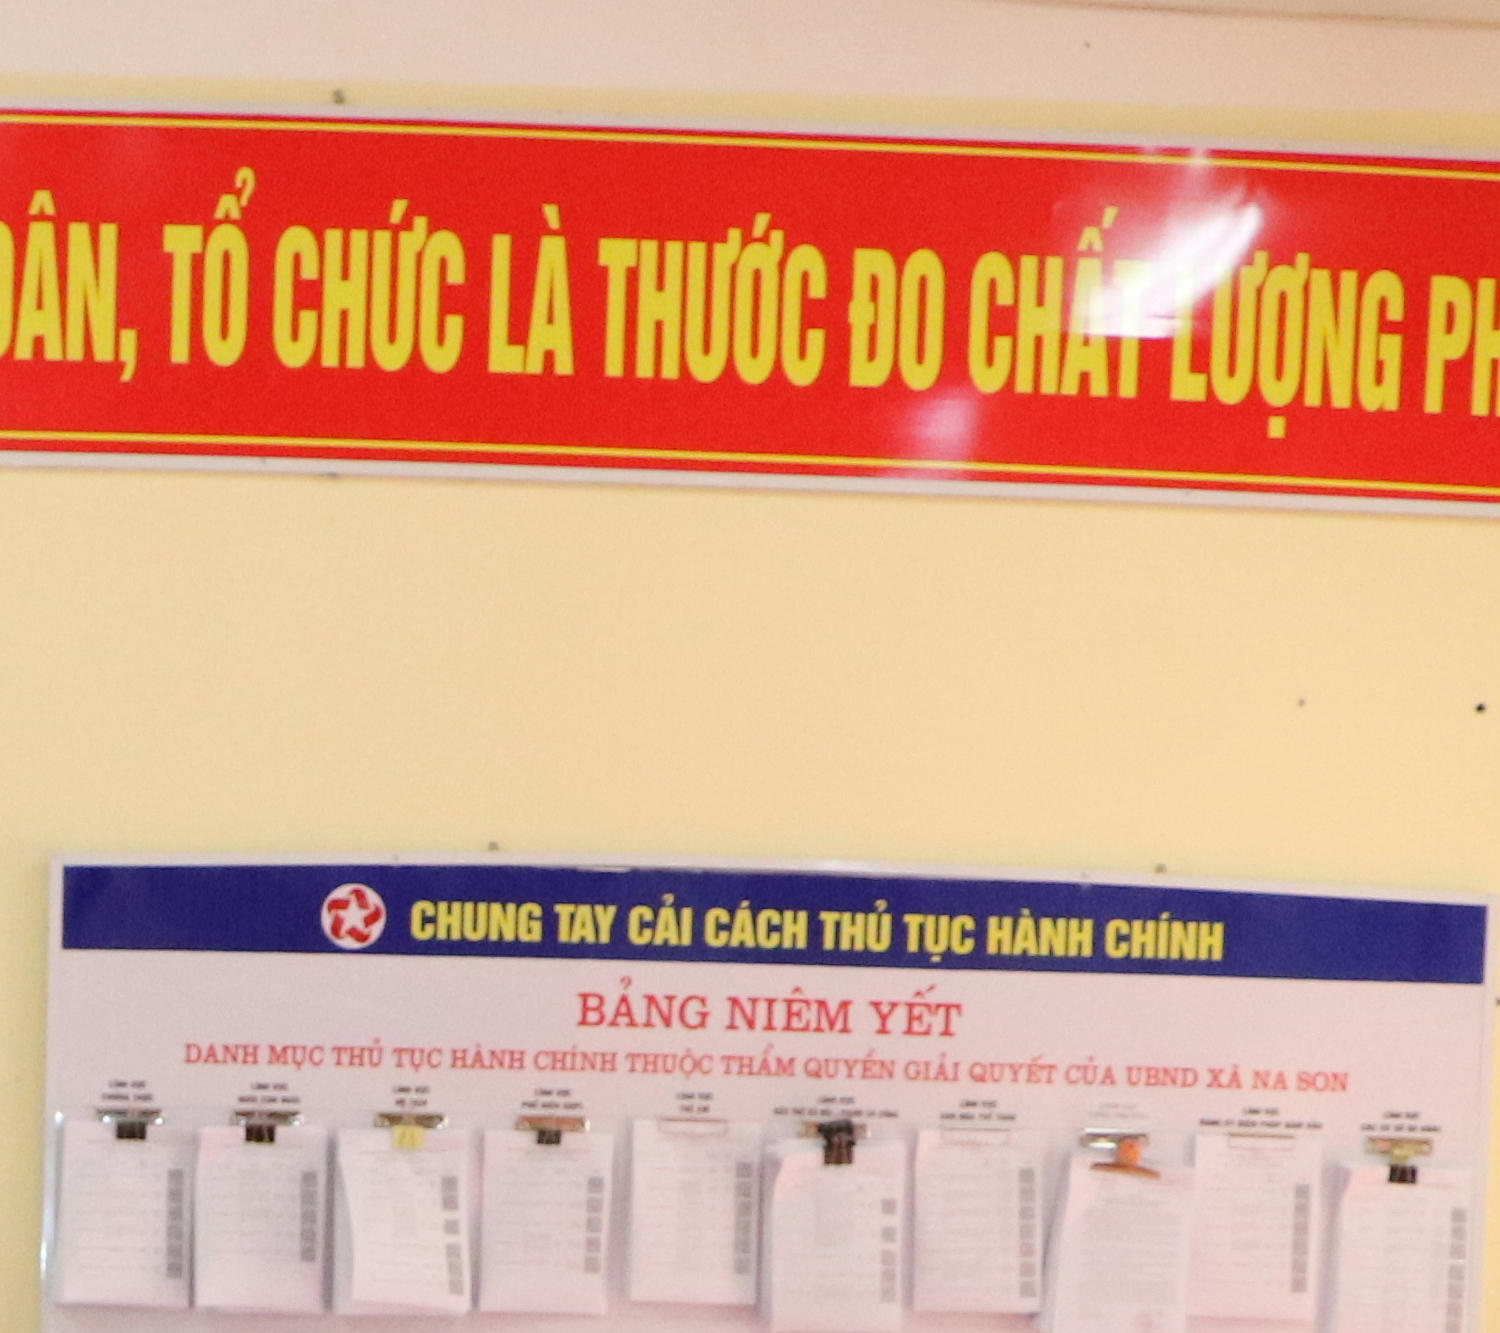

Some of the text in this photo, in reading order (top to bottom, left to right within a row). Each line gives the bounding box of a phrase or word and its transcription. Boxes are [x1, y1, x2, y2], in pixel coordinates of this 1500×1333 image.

[163, 167, 255, 365] TỔ
[273, 199, 465, 372] CHỨC
[489, 204, 573, 374] LÀ
[599, 213, 827, 386] THƯỚC
[848, 249, 945, 390] ĐO
[968, 207, 1150, 398] CHẤT
[1170, 250, 1404, 438] LƯỢNG
[411, 893, 1225, 963] CHUNG TAY CẢI CÁCH THỦ TỤC HÀNH CHÍNH
[576, 976, 964, 1038] BẢNG NIÊM YẾT
[185, 1043, 259, 1066] DANH
[267, 1045, 326, 1070] MỤC
[332, 1037, 383, 1068] THỦ
[393, 1046, 443, 1071] TỤC
[451, 1044, 526, 1071] HÀNH
[533, 1046, 618, 1073] CHÍNH
[625, 1047, 713, 1079] THUỘC
[904, 1053, 961, 1083] GIẢI
[969, 1054, 1058, 1084] QUYẾT
[1065, 1055, 1117, 1086] CỦA
[1126, 1065, 1199, 1088] UBND
[1252, 1069, 1288, 1091] NA
